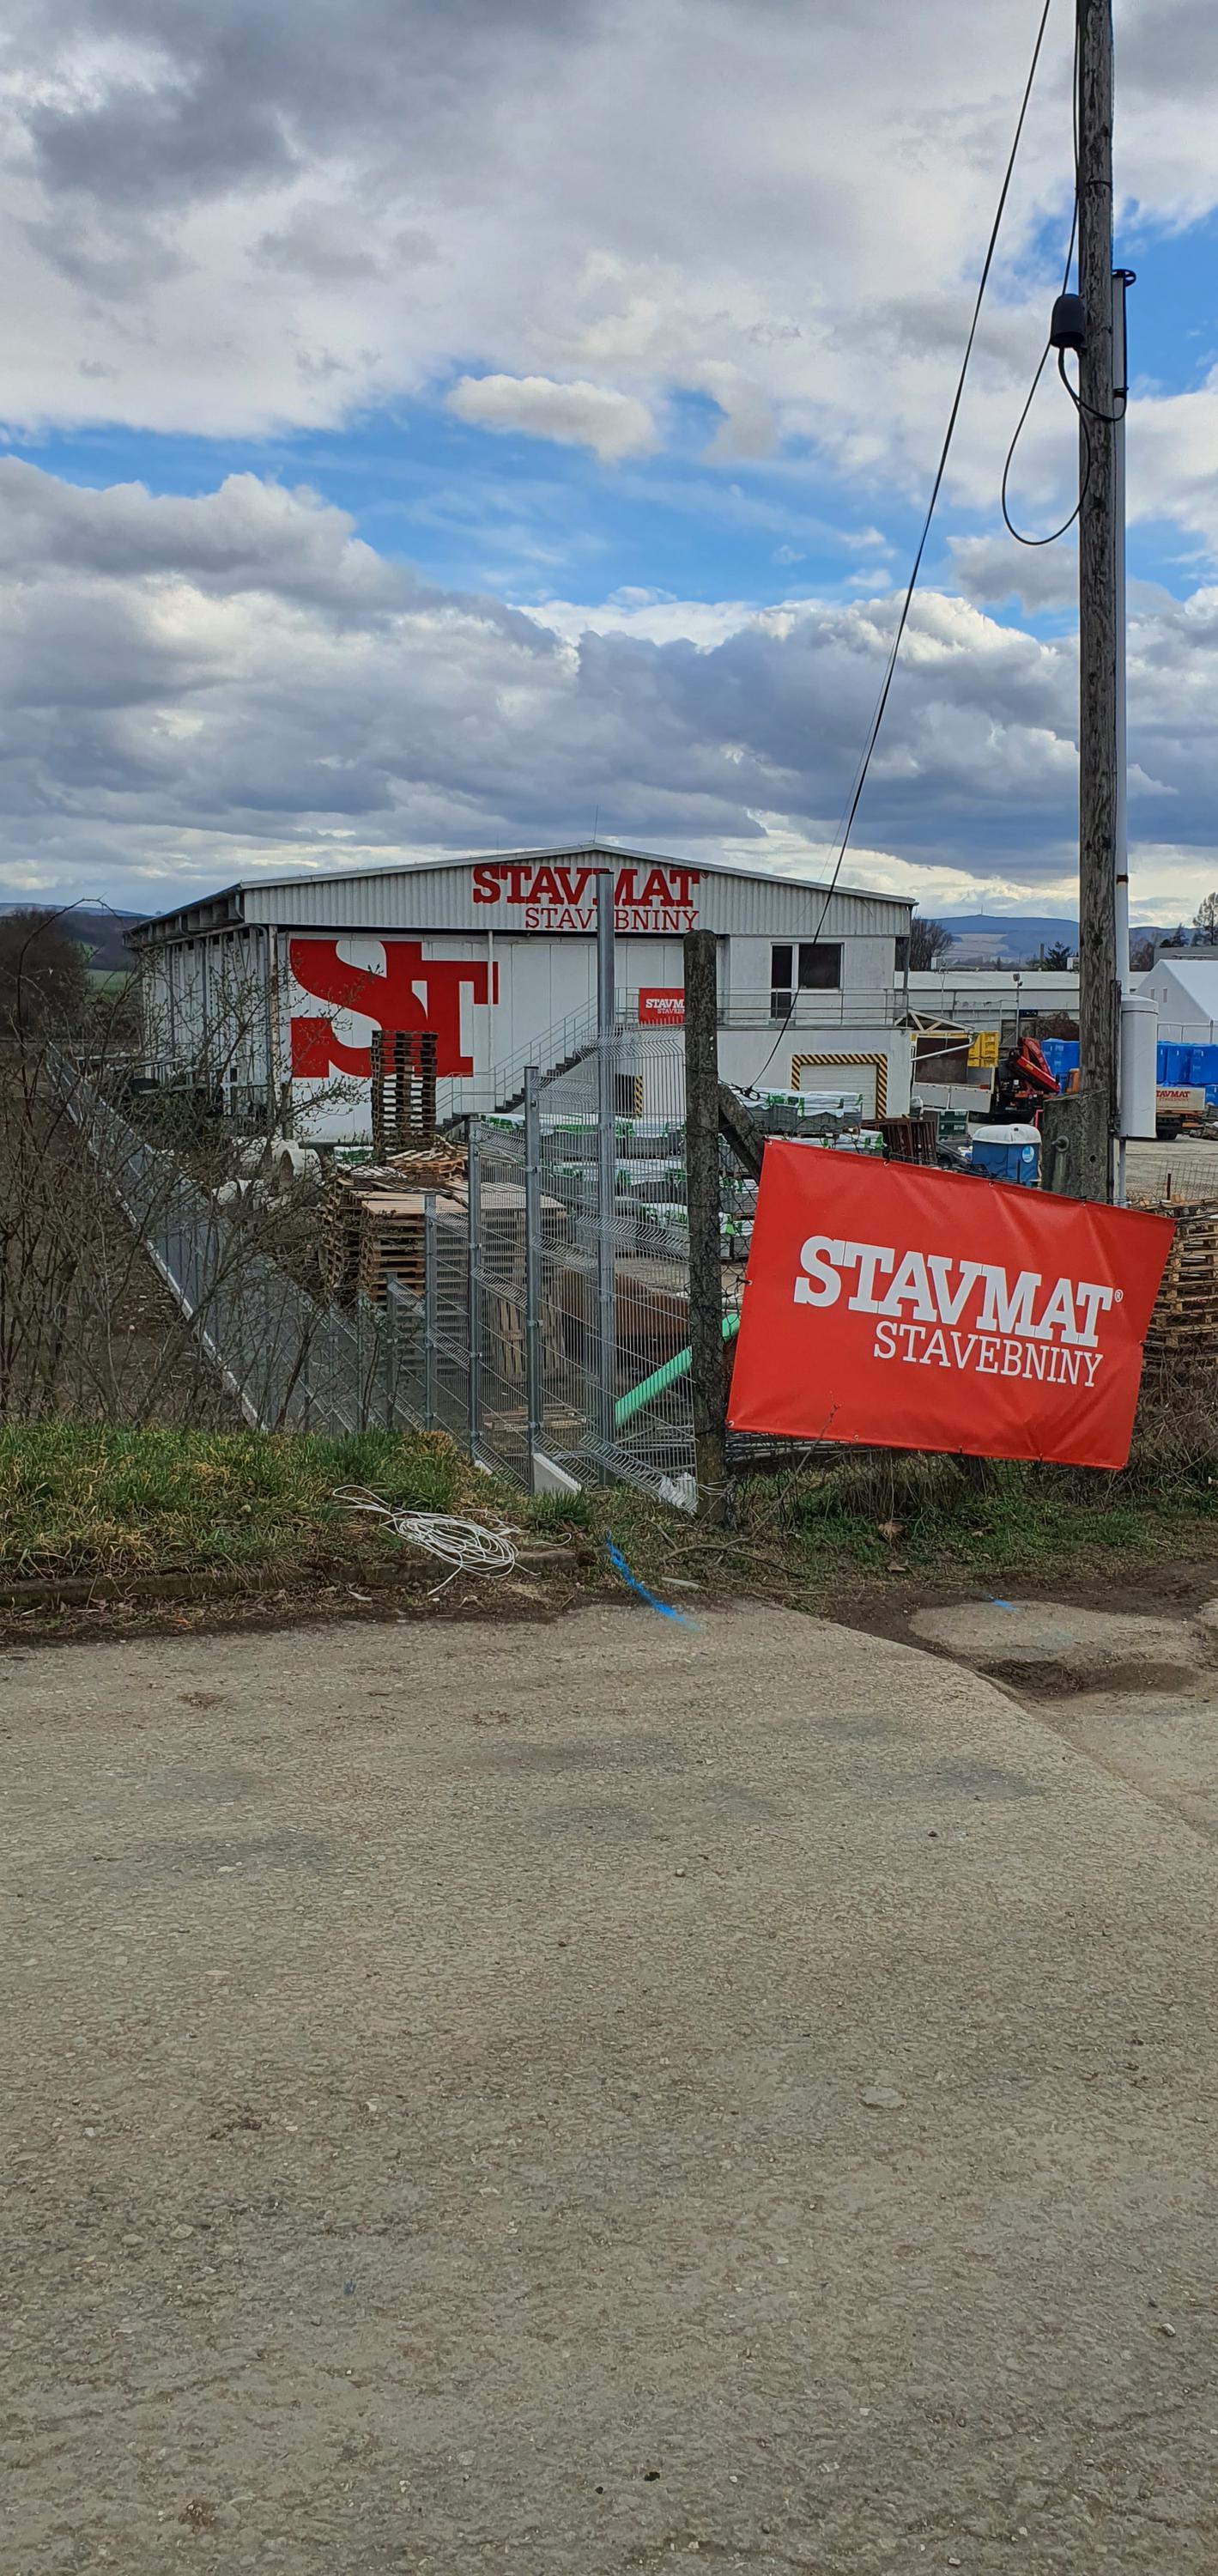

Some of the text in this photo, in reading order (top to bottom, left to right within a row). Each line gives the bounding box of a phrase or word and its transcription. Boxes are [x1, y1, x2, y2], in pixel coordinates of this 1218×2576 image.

[524, 908, 700, 931] STAVBNINY
[289, 938, 500, 1078] ST
[645, 998, 685, 1009] STAVM
[1155, 1090, 1191, 1098] TAVMAT
[873, 1321, 1104, 1388] STAVEBNINY
